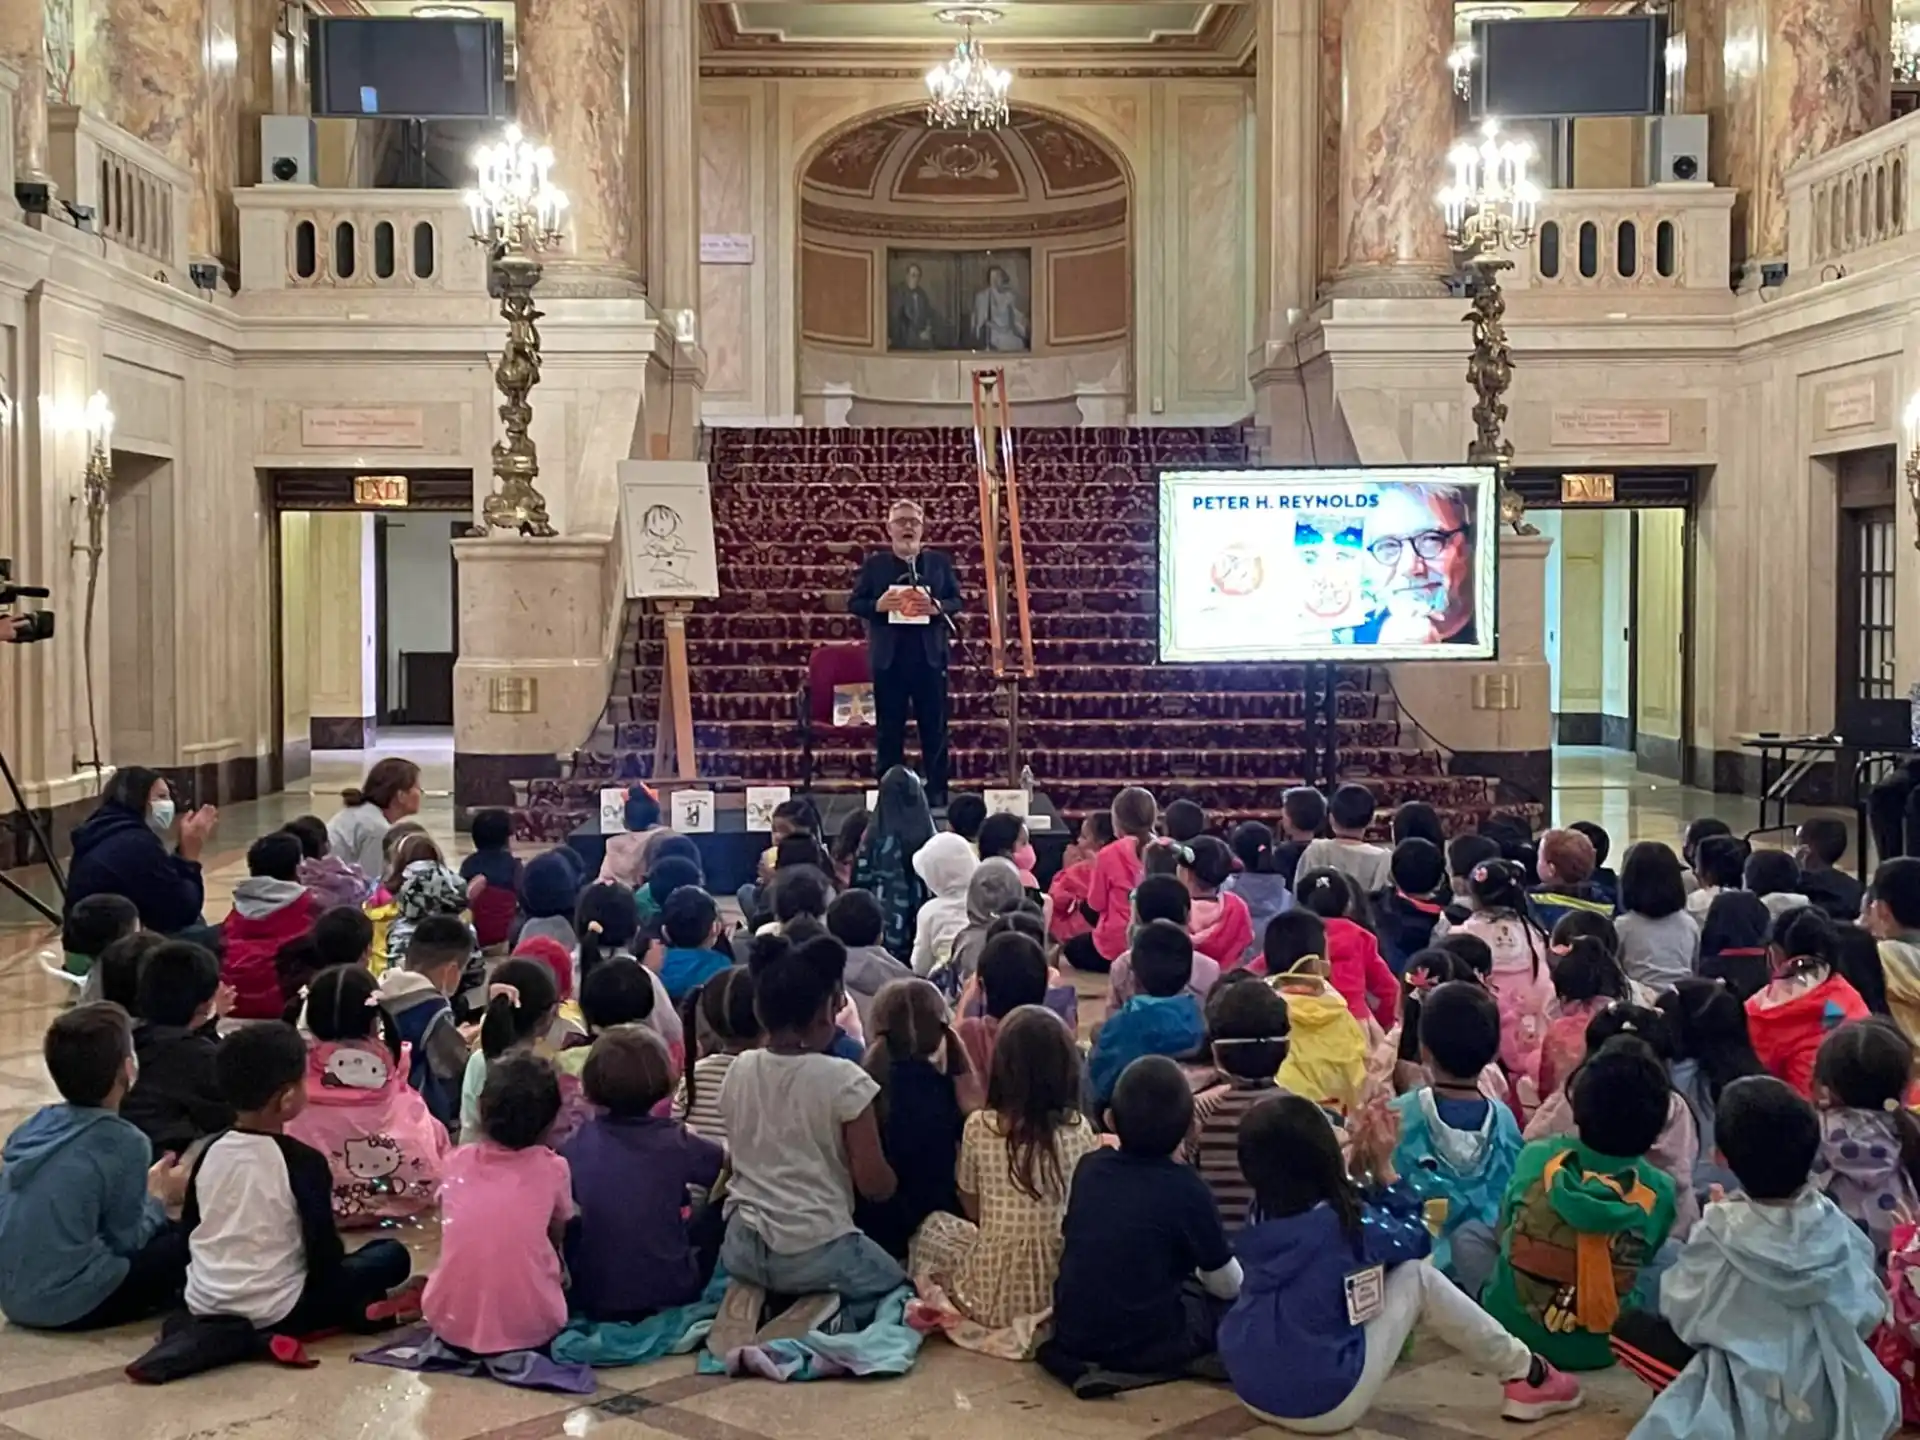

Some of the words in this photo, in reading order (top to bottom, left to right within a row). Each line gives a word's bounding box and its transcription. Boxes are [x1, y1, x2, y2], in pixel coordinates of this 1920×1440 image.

[1193, 496, 1249, 509] PETER
[1256, 496, 1273, 508] H.
[1279, 494, 1379, 508] REYNOLDS
